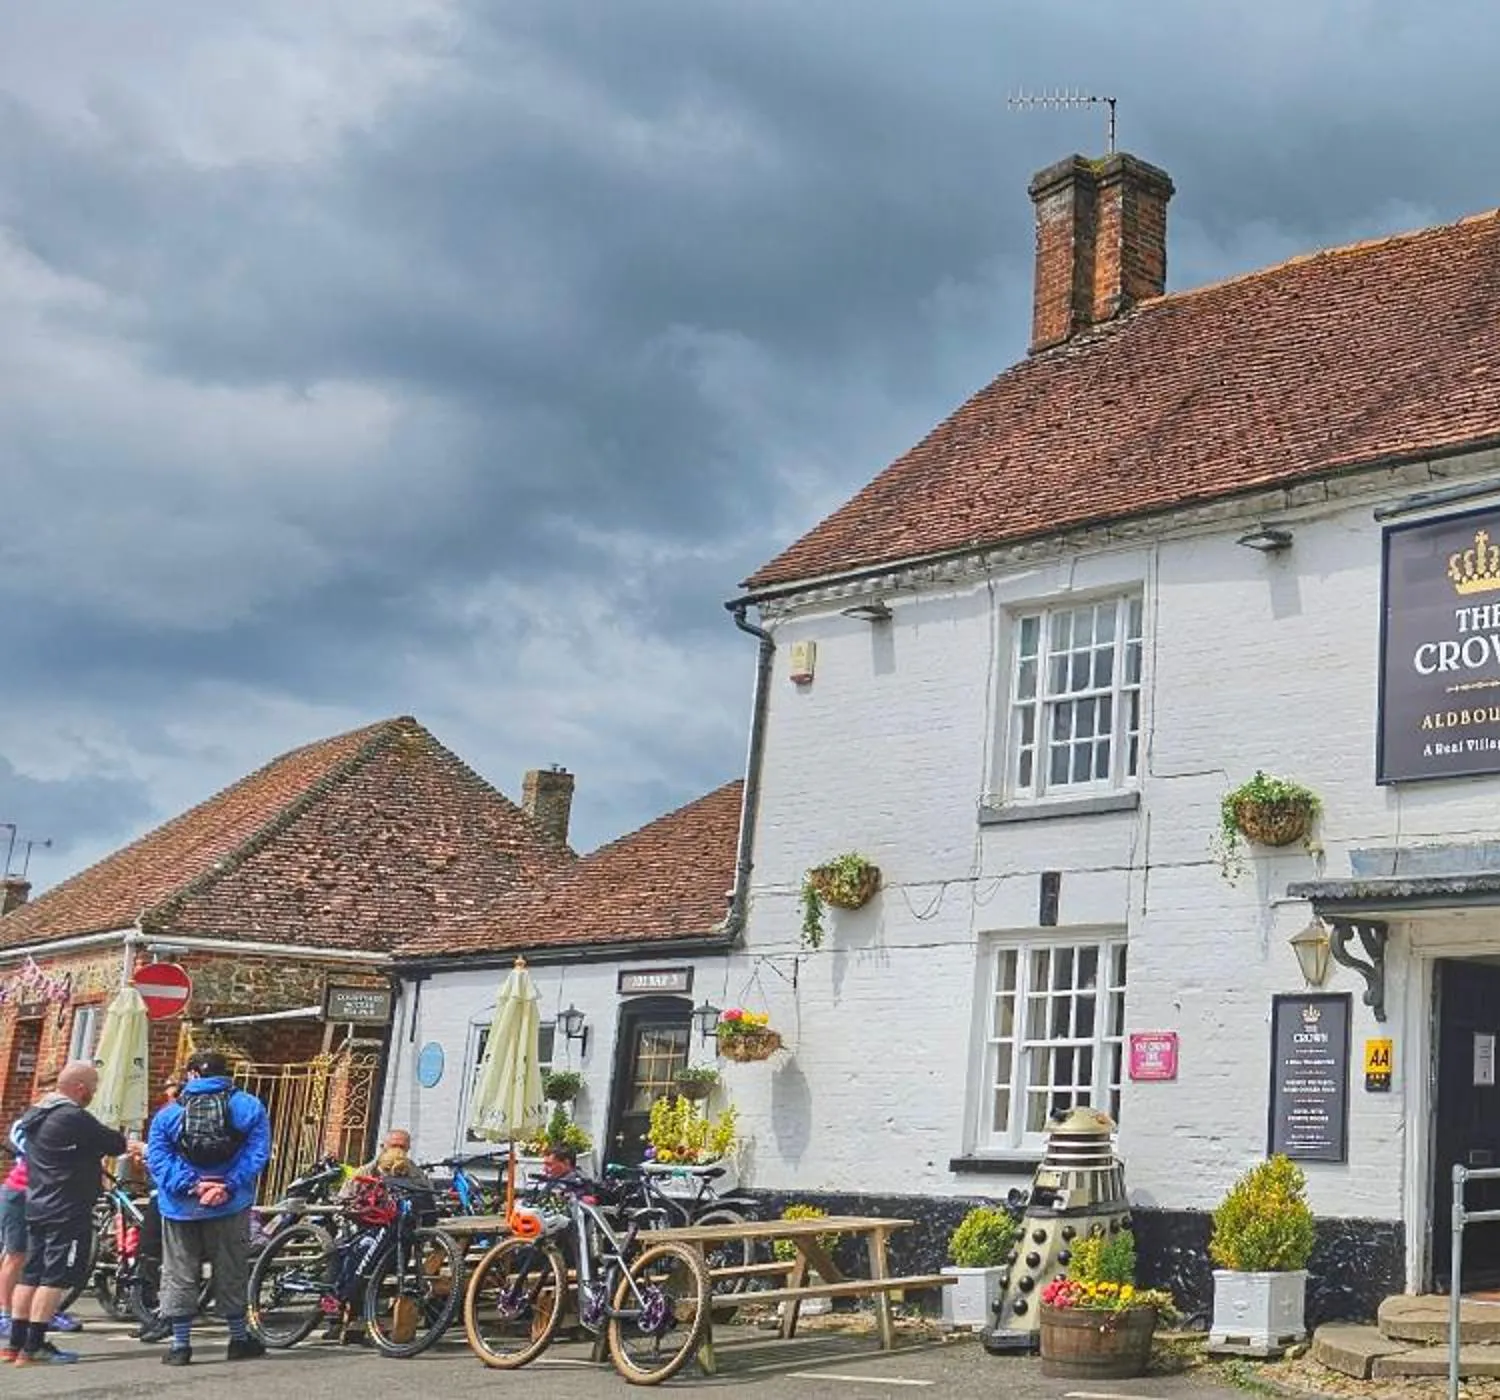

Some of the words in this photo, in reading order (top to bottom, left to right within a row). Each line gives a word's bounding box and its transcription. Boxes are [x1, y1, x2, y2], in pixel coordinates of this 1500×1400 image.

[1423, 743, 1434, 757] A
[1436, 740, 1463, 756] Real
[1369, 1049, 1389, 1067] AA
